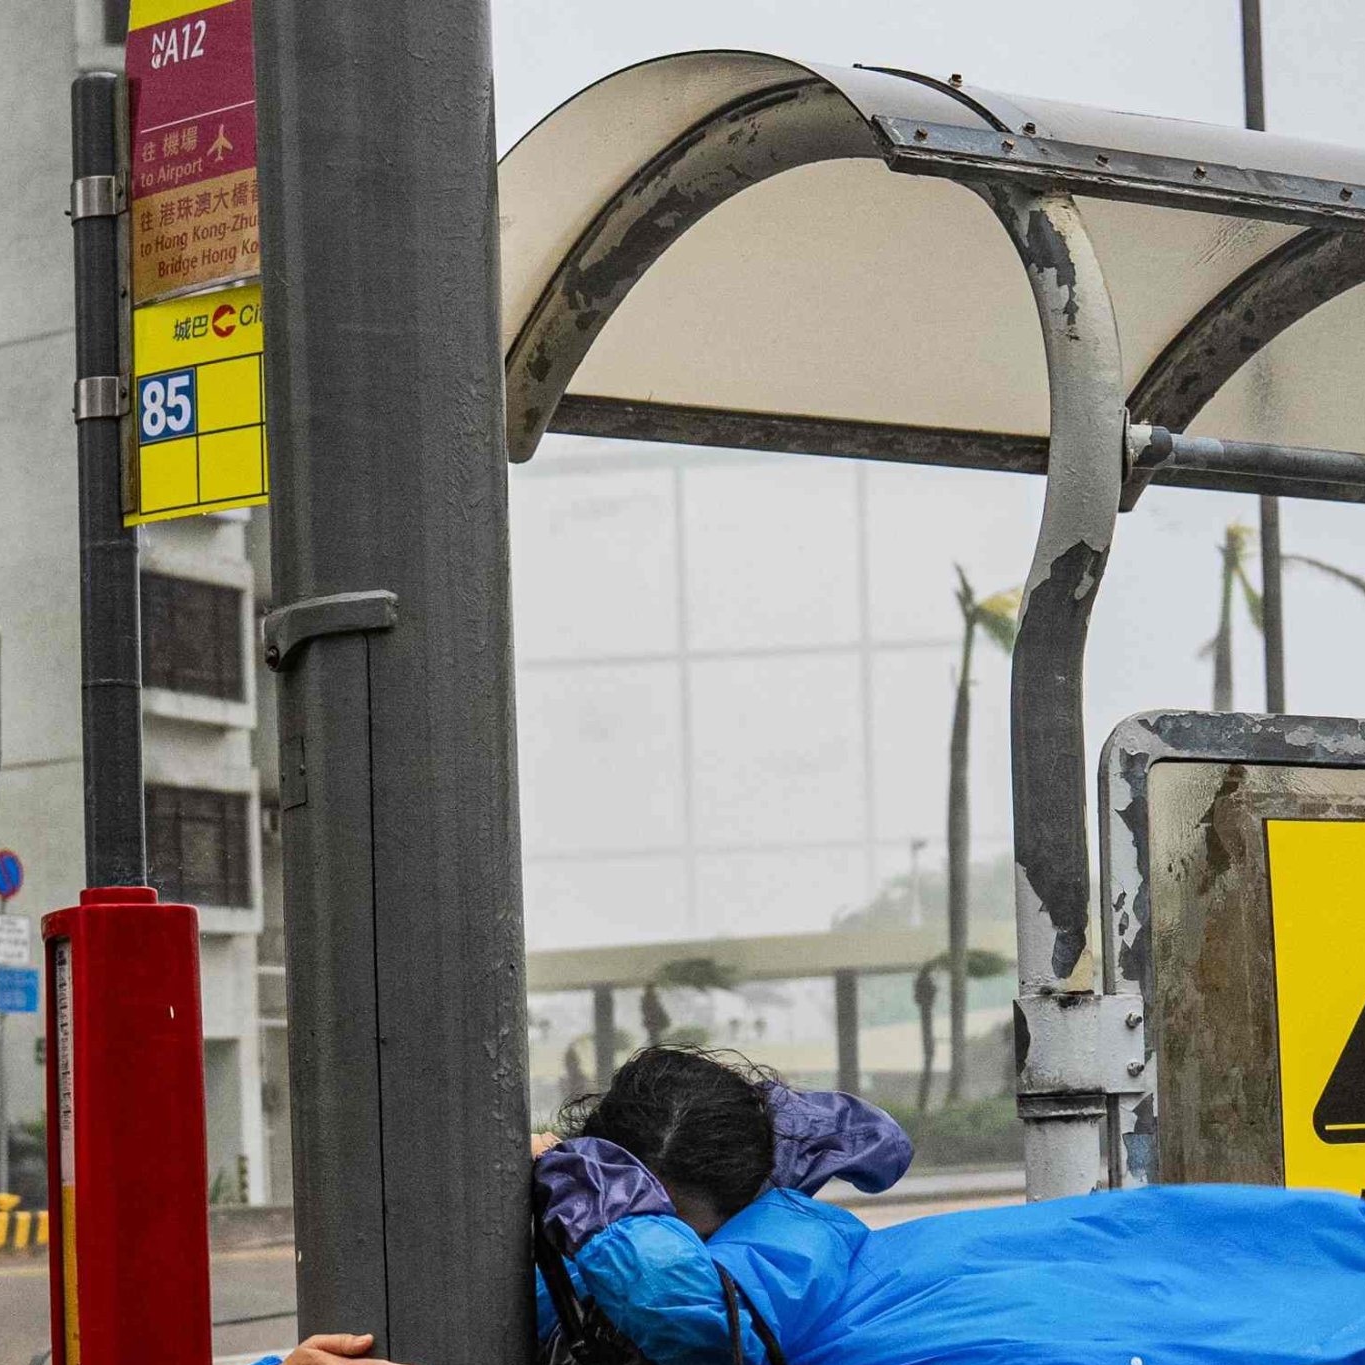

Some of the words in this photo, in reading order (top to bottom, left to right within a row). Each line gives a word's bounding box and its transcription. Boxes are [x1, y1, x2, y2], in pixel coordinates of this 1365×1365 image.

[162, 126, 198, 158] 機場
[140, 173, 154, 188] to
[157, 157, 203, 184] Airport
[140, 242, 152, 258] to
[155, 231, 188, 251] Hong
[158, 256, 198, 278] Bridge
[202, 245, 236, 266] Hong
[173, 314, 209, 341] 城巴
[142, 374, 192, 437] 85
